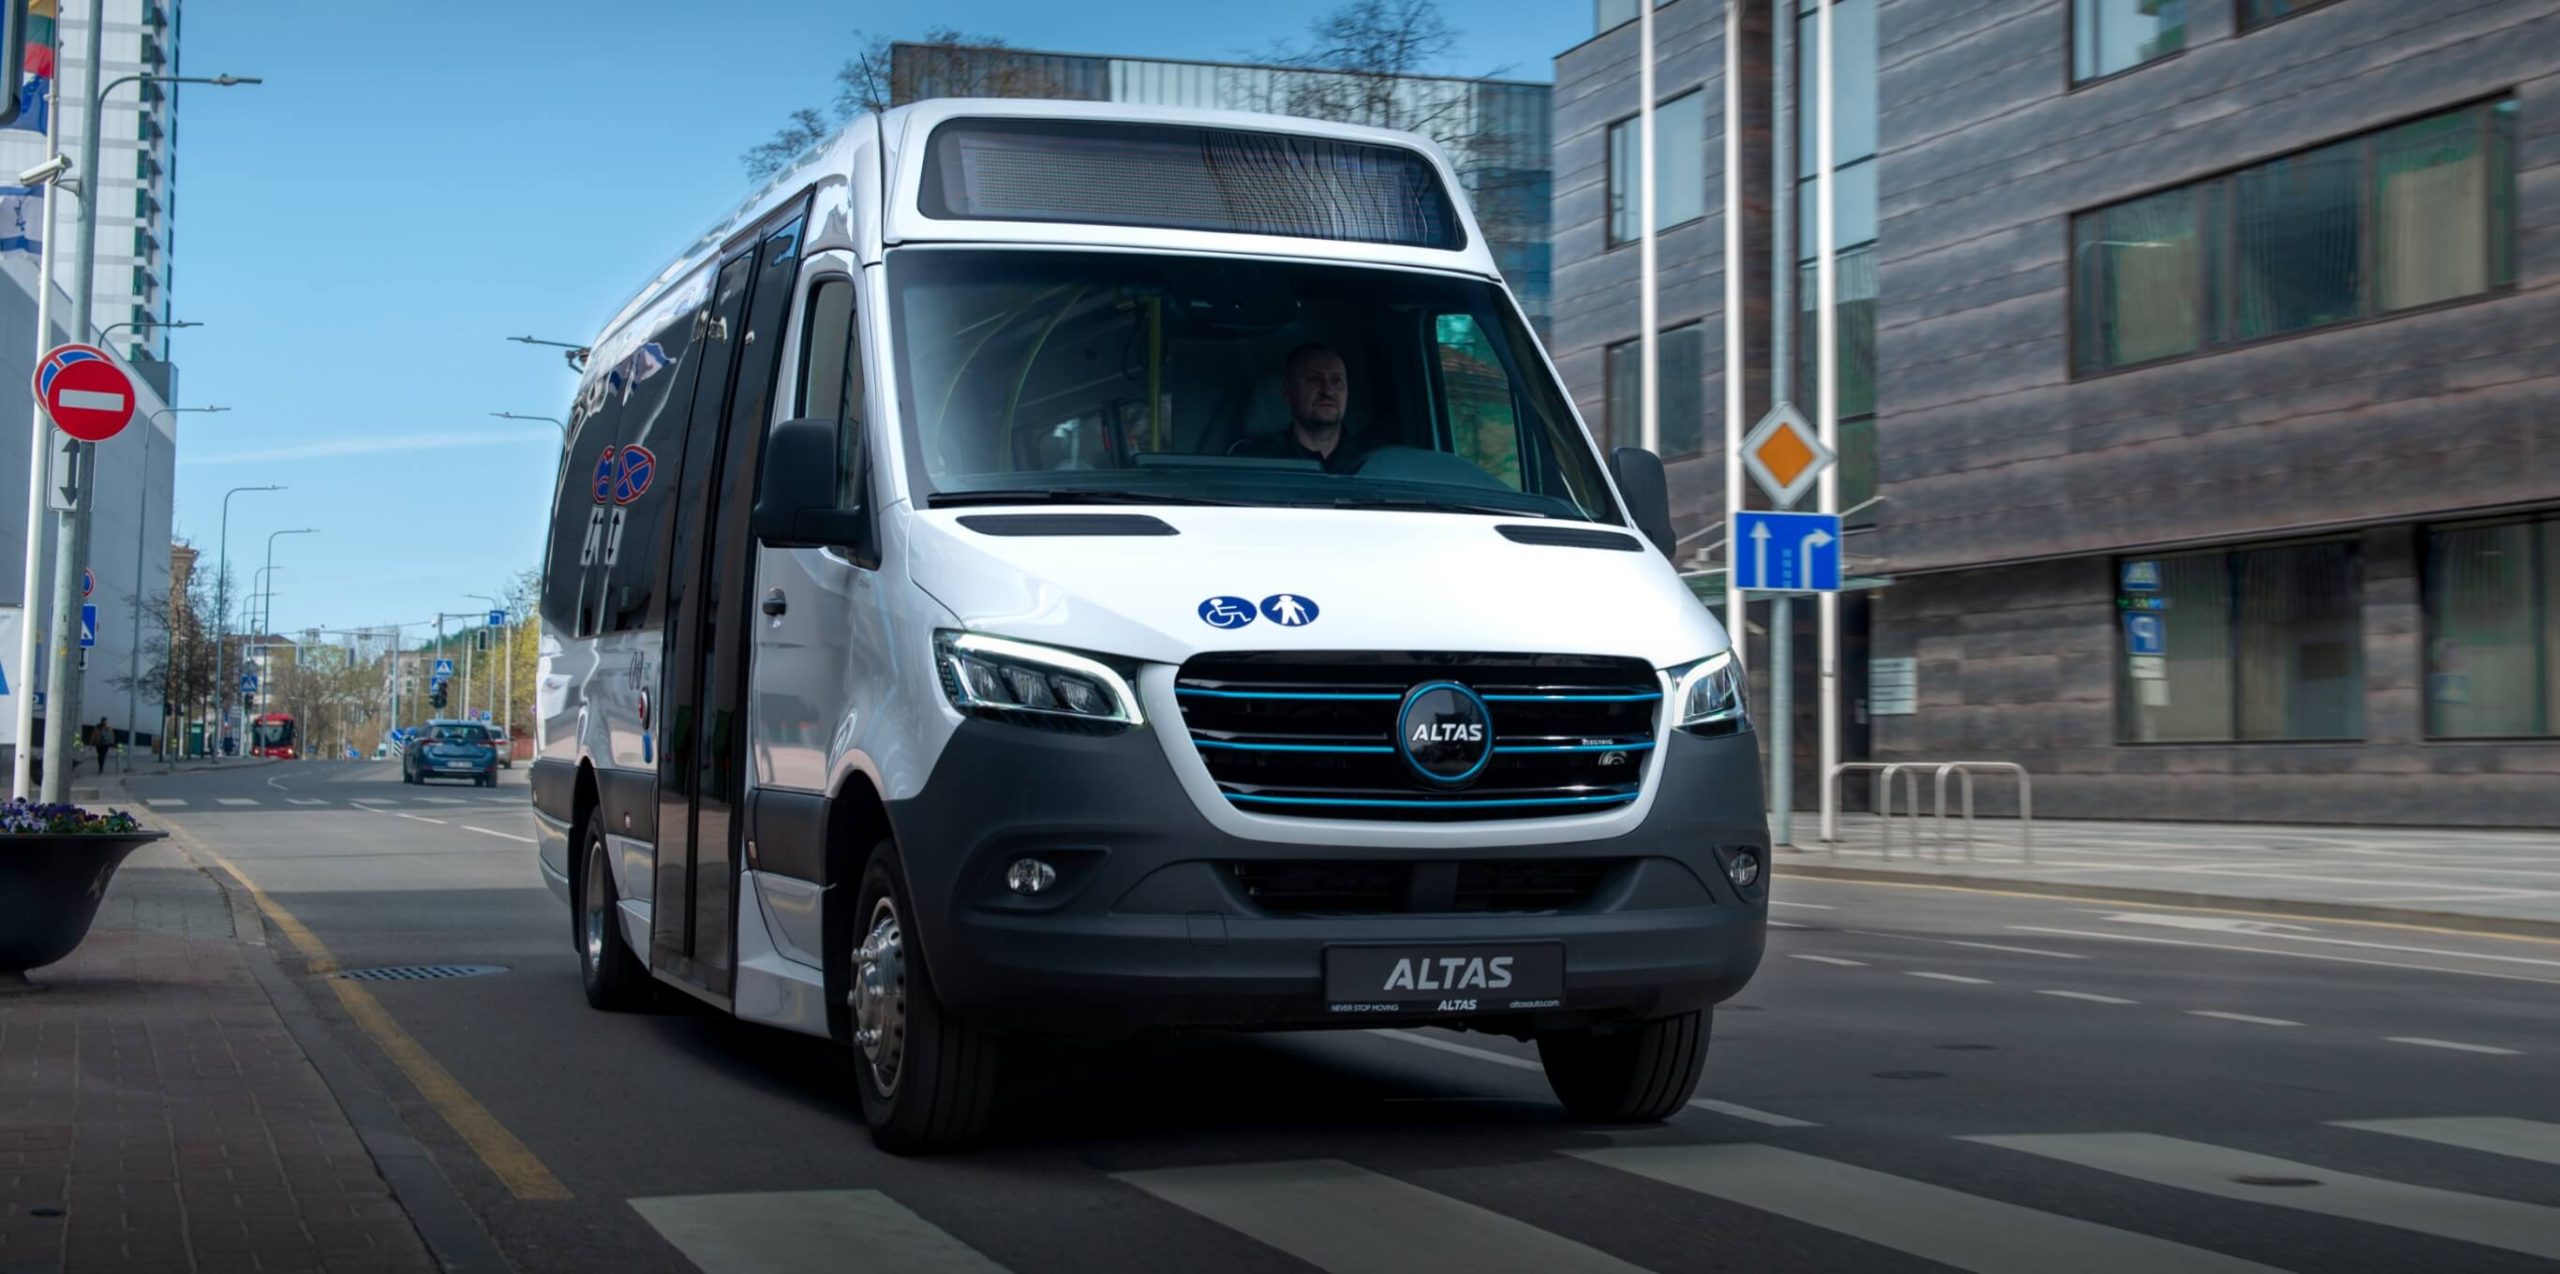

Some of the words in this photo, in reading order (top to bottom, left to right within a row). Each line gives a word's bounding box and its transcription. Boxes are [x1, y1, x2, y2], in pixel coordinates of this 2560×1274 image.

[1411, 723, 1483, 742] ALTAS
[1383, 957, 1514, 990] ALTAS
[1353, 1003, 1371, 1012] STOP
[1371, 1003, 1399, 1012] MOVING
[1437, 999, 1477, 1011] ALTAS
